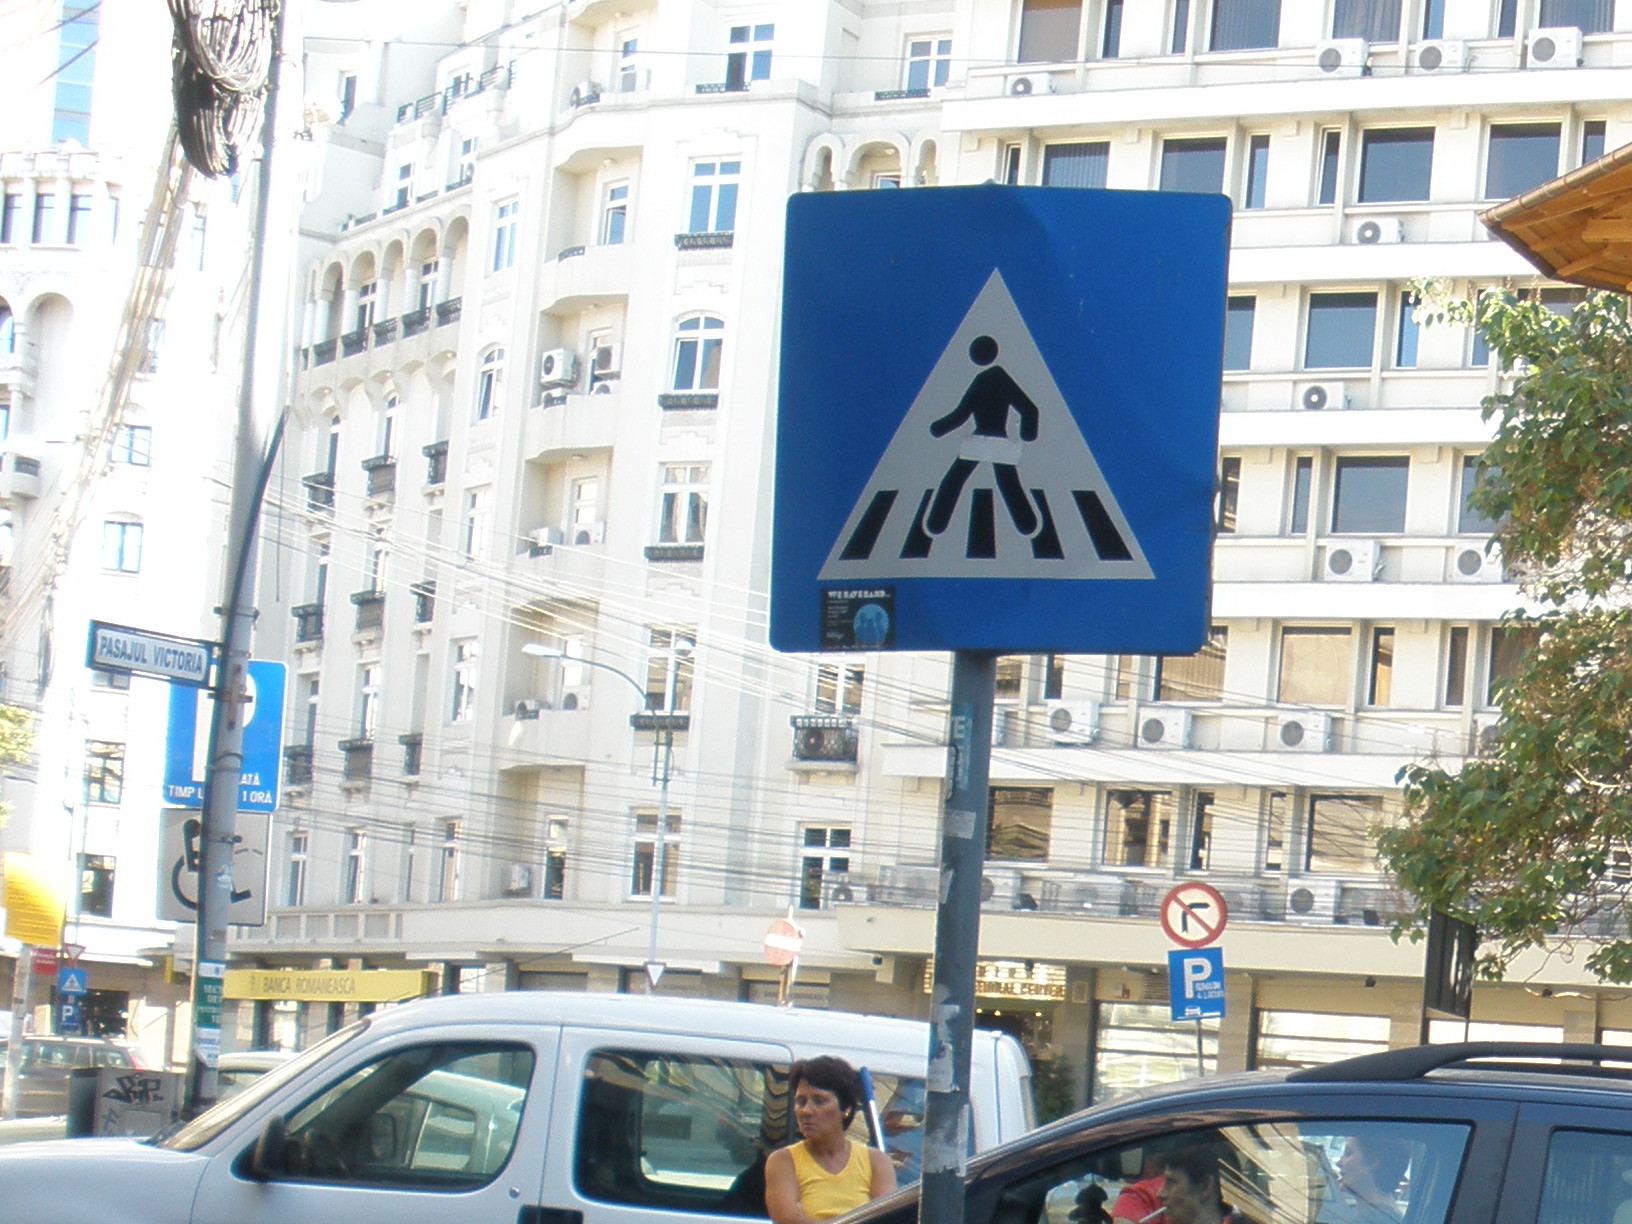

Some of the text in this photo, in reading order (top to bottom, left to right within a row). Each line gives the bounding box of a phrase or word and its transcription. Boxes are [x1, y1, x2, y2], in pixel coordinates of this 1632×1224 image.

[99, 635, 204, 673] PASAJUL VICTORIA
[168, 785, 194, 799] TIMP
[262, 976, 292, 994] BANCA
[1183, 957, 1212, 999] P
[61, 1005, 74, 1021] P
